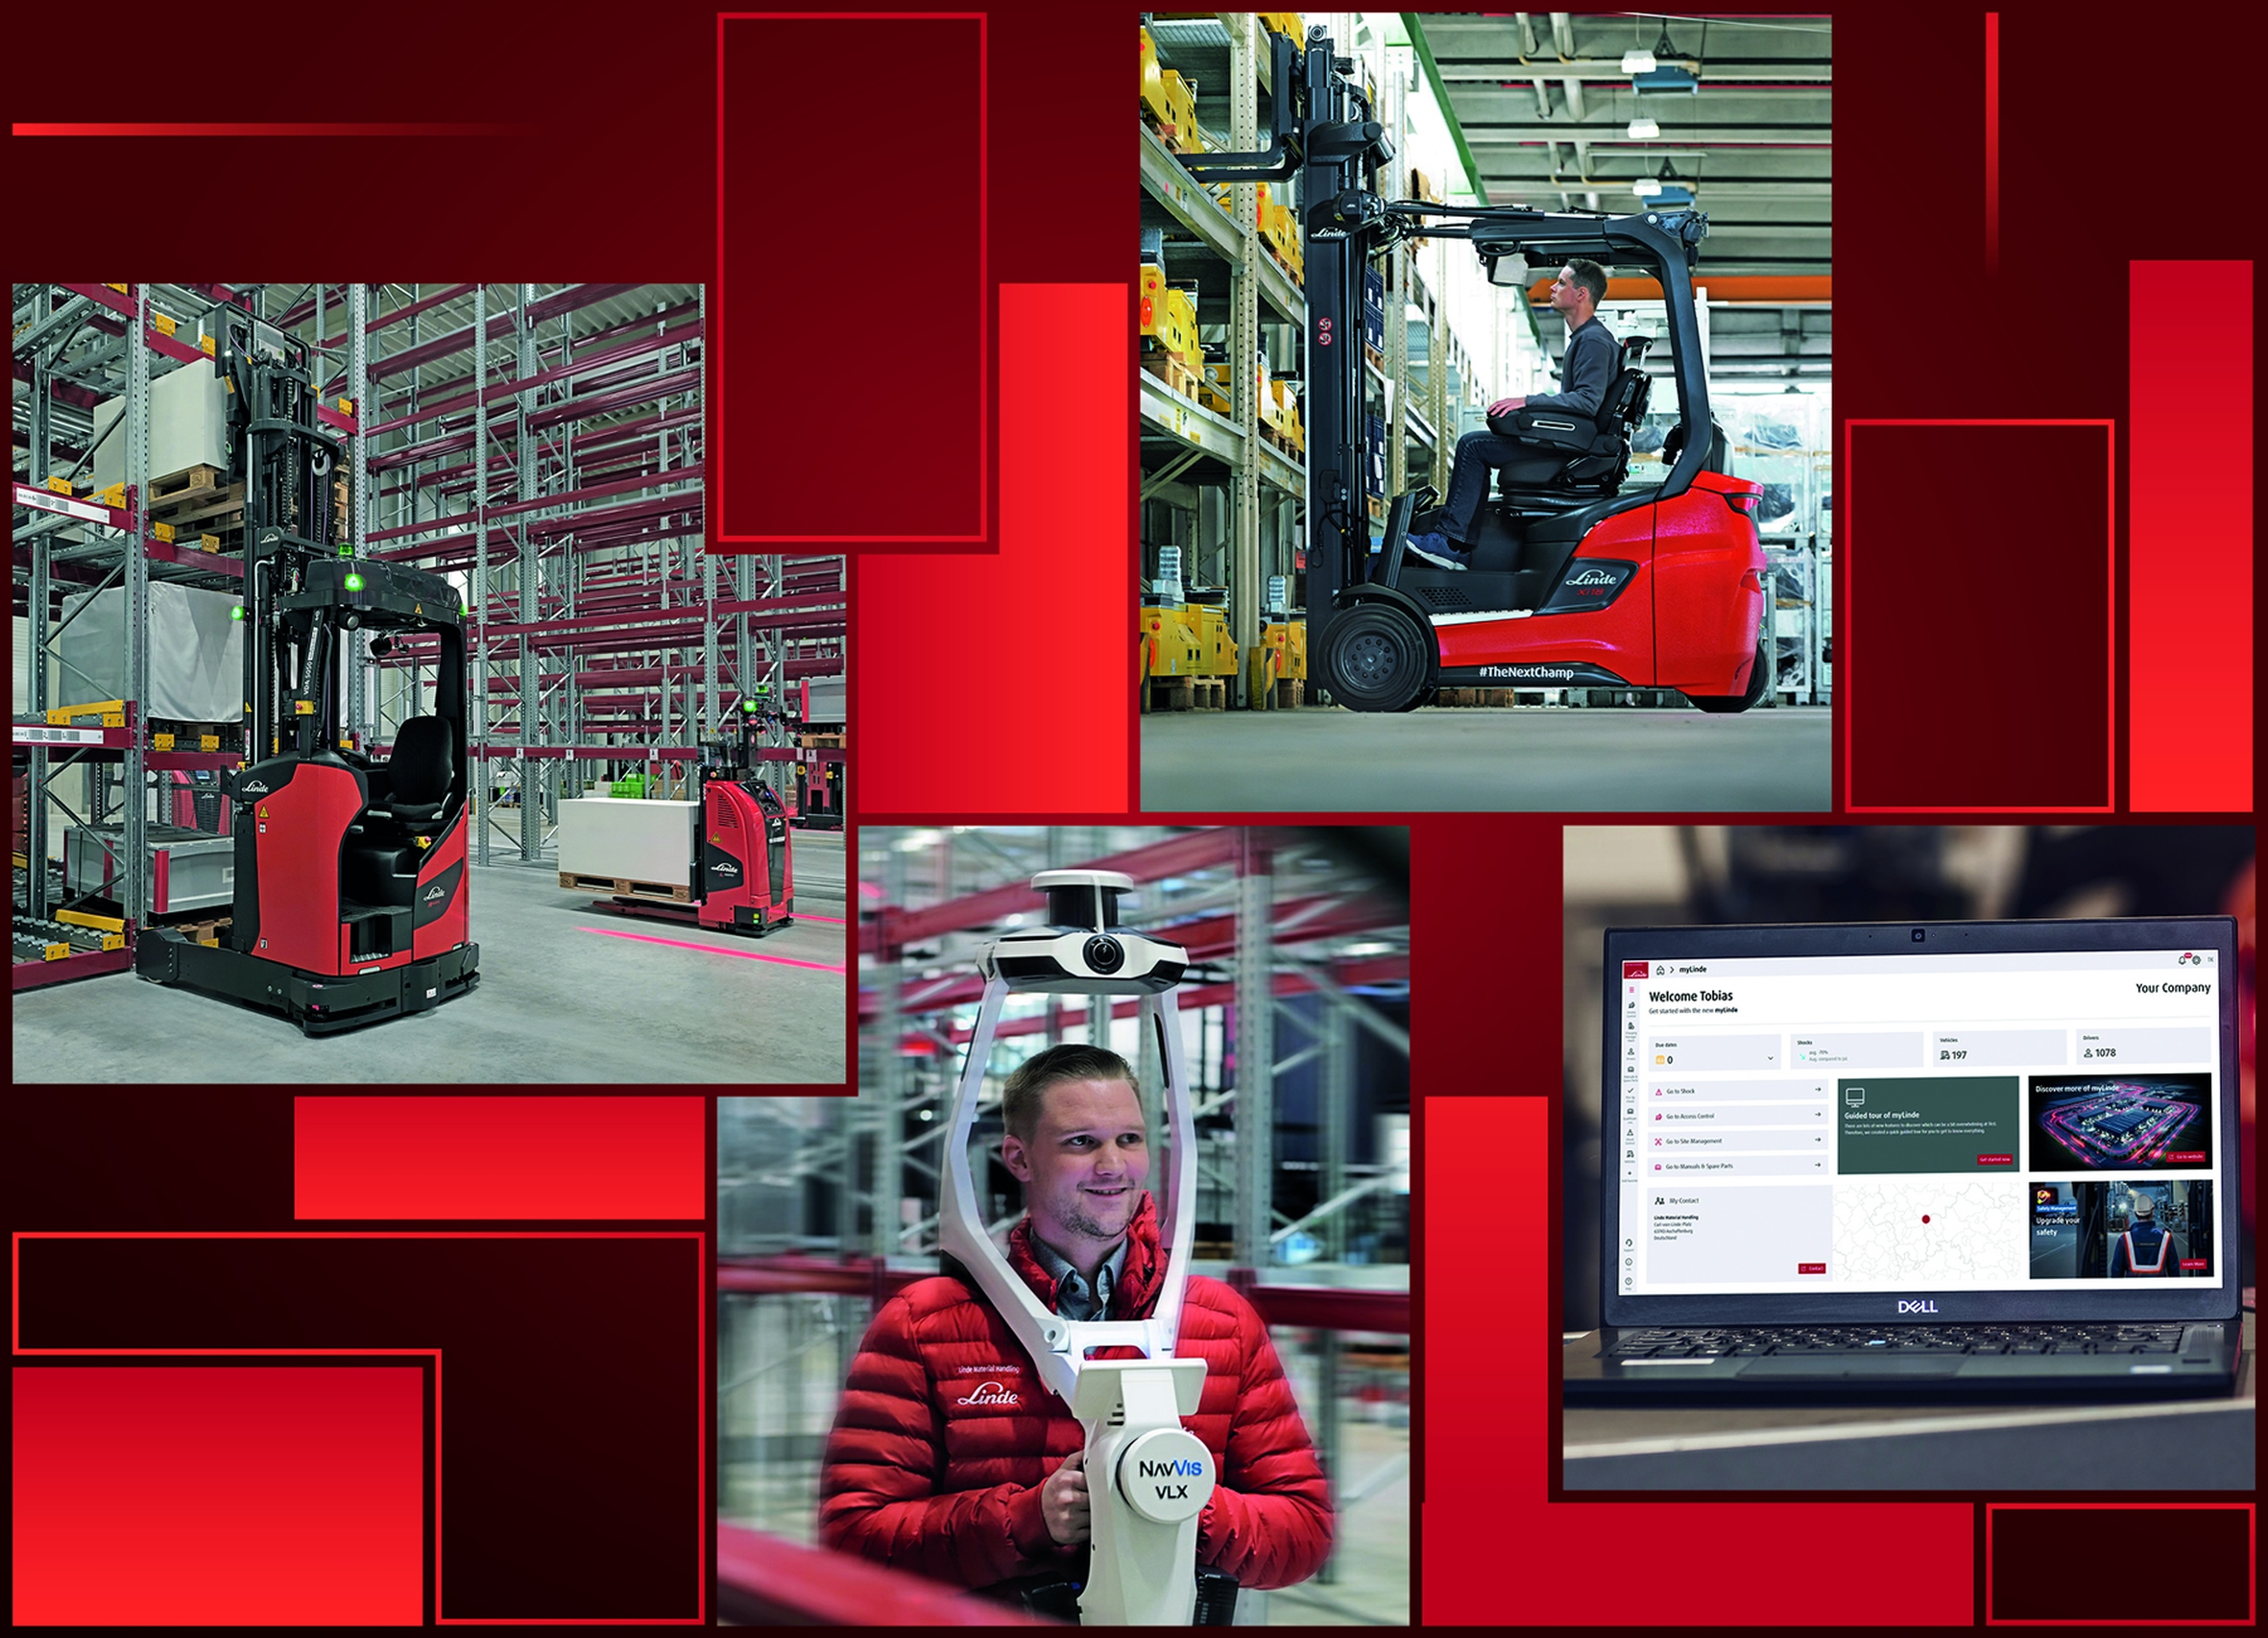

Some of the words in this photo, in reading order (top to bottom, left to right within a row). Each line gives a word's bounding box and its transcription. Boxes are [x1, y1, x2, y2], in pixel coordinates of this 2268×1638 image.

[1311, 226, 1347, 238] Linde
[1565, 568, 1617, 586] Linde
[1479, 665, 1575, 681] #TheNextChamp
[242, 780, 269, 793] Linde
[711, 862, 738, 874] Linde
[1678, 965, 1707, 974] myLinde
[2135, 983, 2159, 994] Your
[2161, 982, 2211, 995] Company
[1649, 990, 1699, 1002] Welcome
[1700, 989, 1734, 1001] Tobias
[1951, 1049, 1967, 1060] 197
[2095, 1048, 2116, 1057] 1078
[1667, 1055, 1674, 1065] 0
[2036, 1084, 2063, 1093] Discover
[2091, 1084, 2119, 1093] myLinde
[1892, 1111, 1920, 1120] myLinde
[2036, 1216, 2064, 1225] Upgrade
[2036, 1228, 2059, 1238] safety
[1897, 1299, 1939, 1313] DELL
[956, 1381, 1018, 1406] Linde
[1155, 1484, 1188, 1500] VLX
